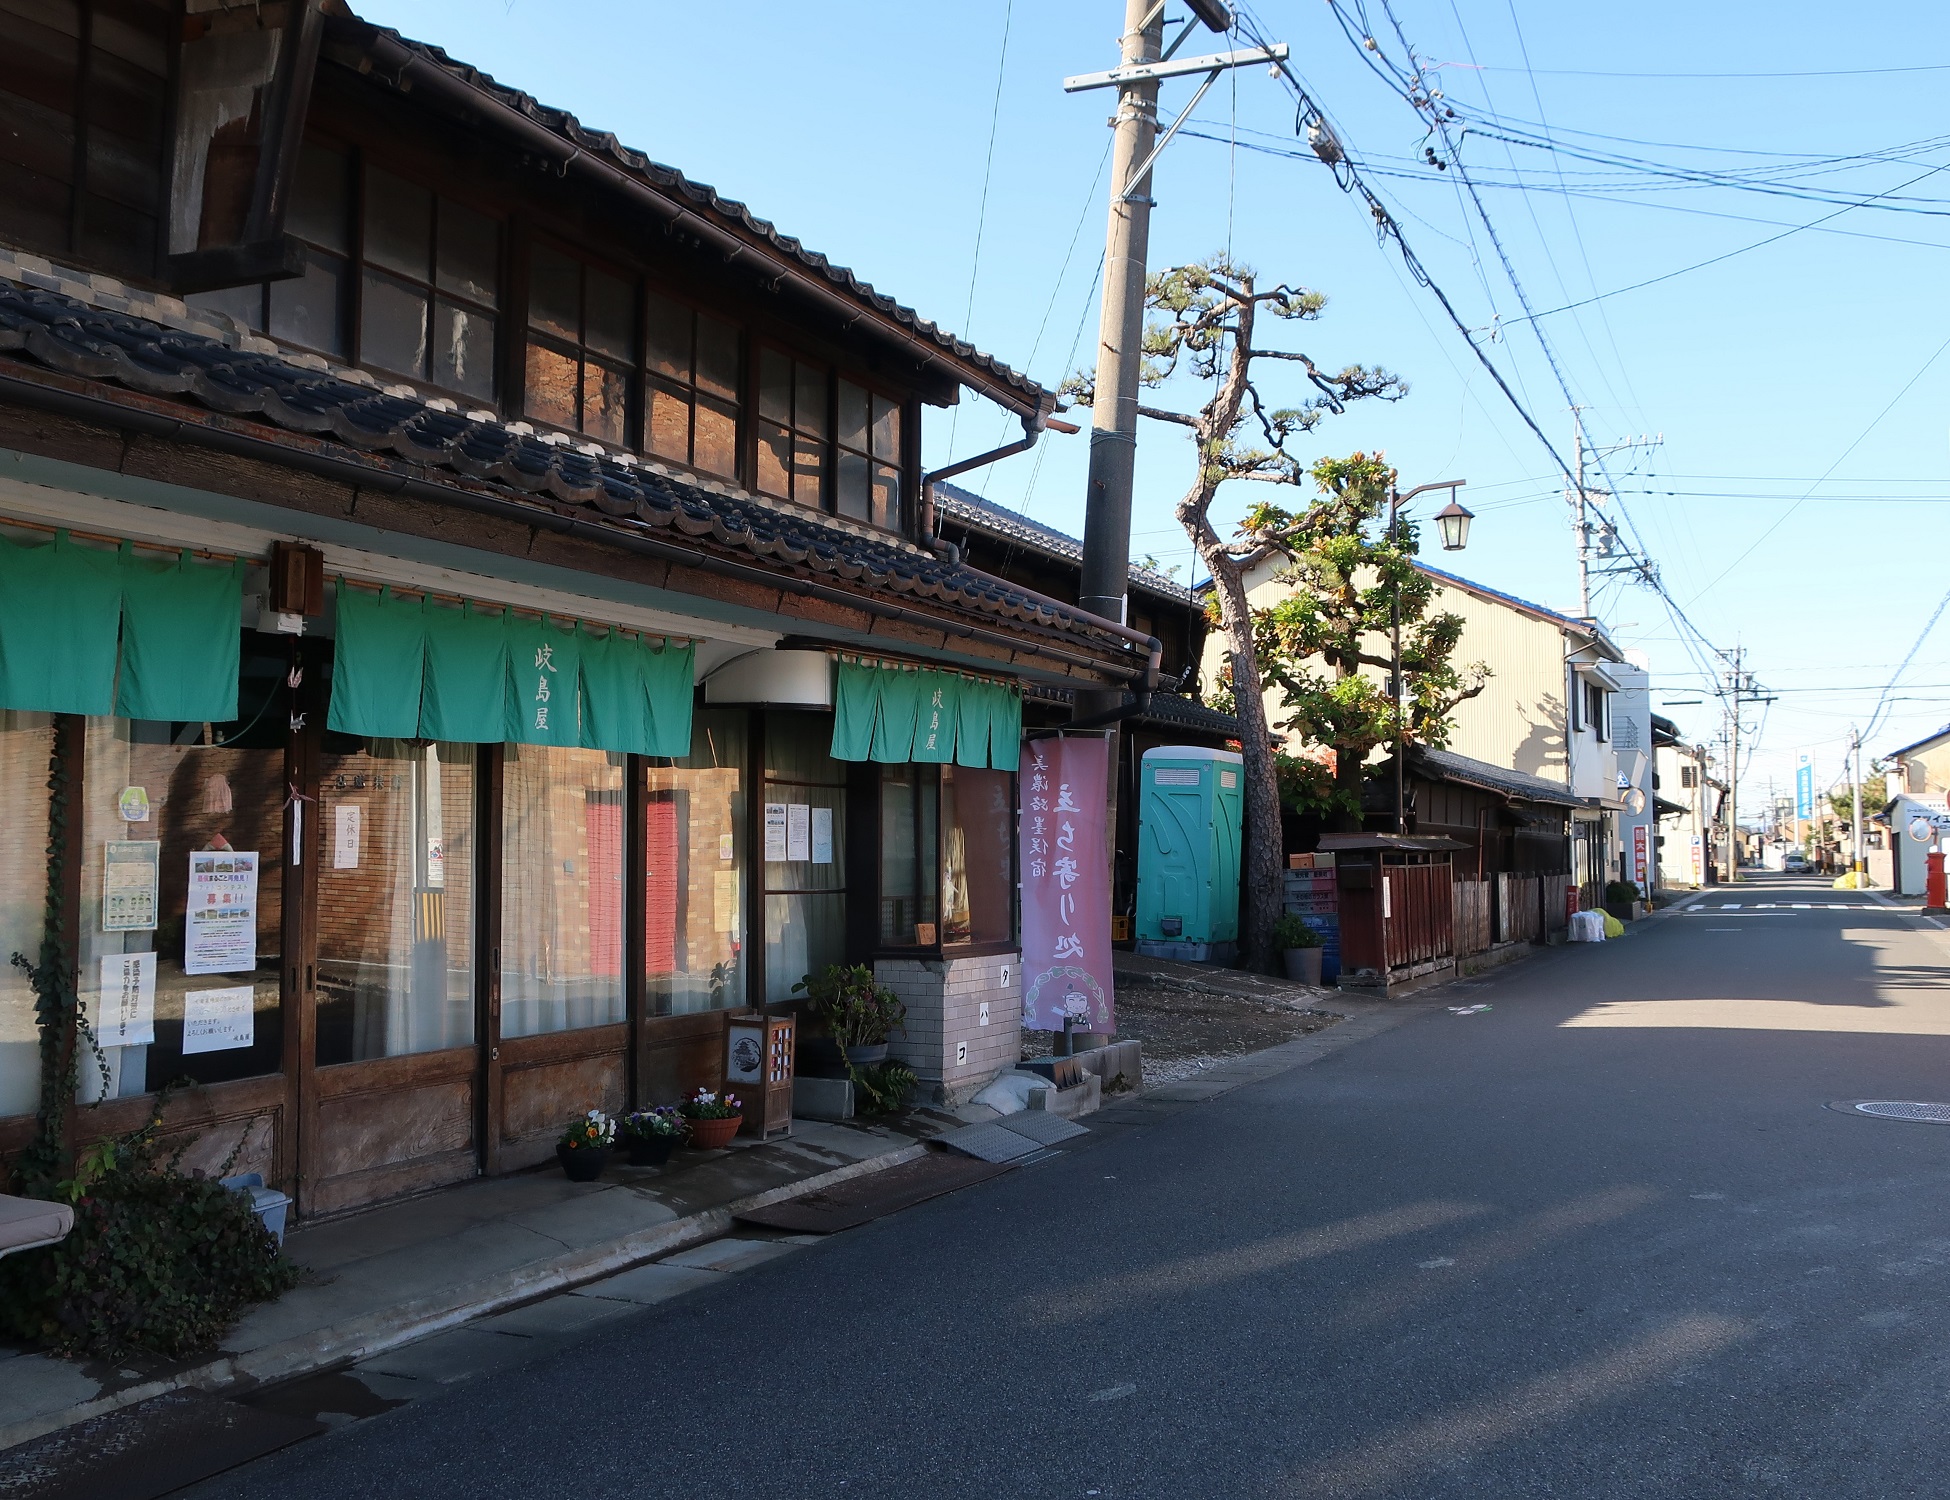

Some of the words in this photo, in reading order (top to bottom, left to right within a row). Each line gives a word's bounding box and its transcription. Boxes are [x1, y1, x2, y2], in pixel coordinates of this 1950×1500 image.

[534, 643, 558, 730] 岐島屋
[925, 687, 944, 751] 岐島屋
[346, 811, 356, 849] 定休日
